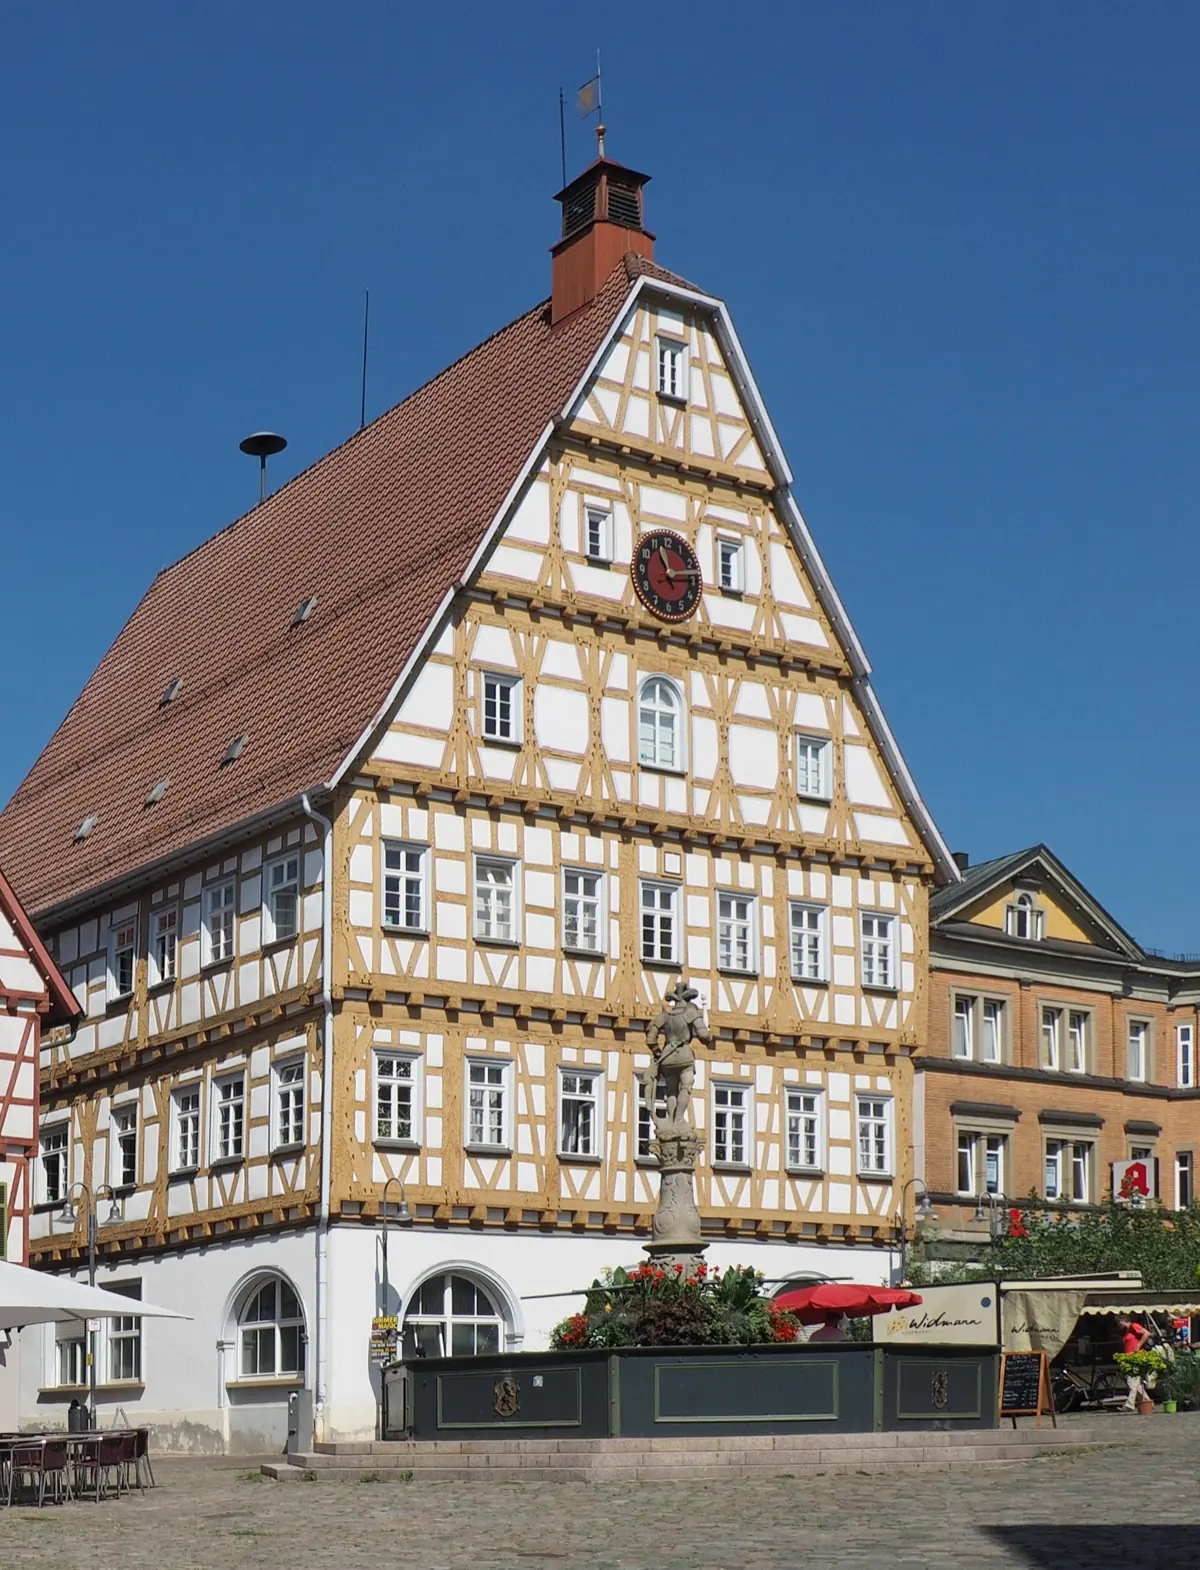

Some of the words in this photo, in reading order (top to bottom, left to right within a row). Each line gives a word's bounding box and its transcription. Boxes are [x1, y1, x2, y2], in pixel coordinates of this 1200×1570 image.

[652, 539, 658, 549] 11
[664, 537, 672, 548] 12
[642, 548, 650, 559] 10
[678, 545, 682, 555] 1
[687, 559, 693, 568] 2
[640, 564, 645, 575] 9
[643, 581, 649, 591] 8
[690, 576, 696, 586] 3
[653, 595, 658, 605] 7
[687, 591, 693, 600] 4
[666, 602, 671, 612] 6
[679, 600, 684, 611] 5
[909, 1312, 982, 1329] Widmann
